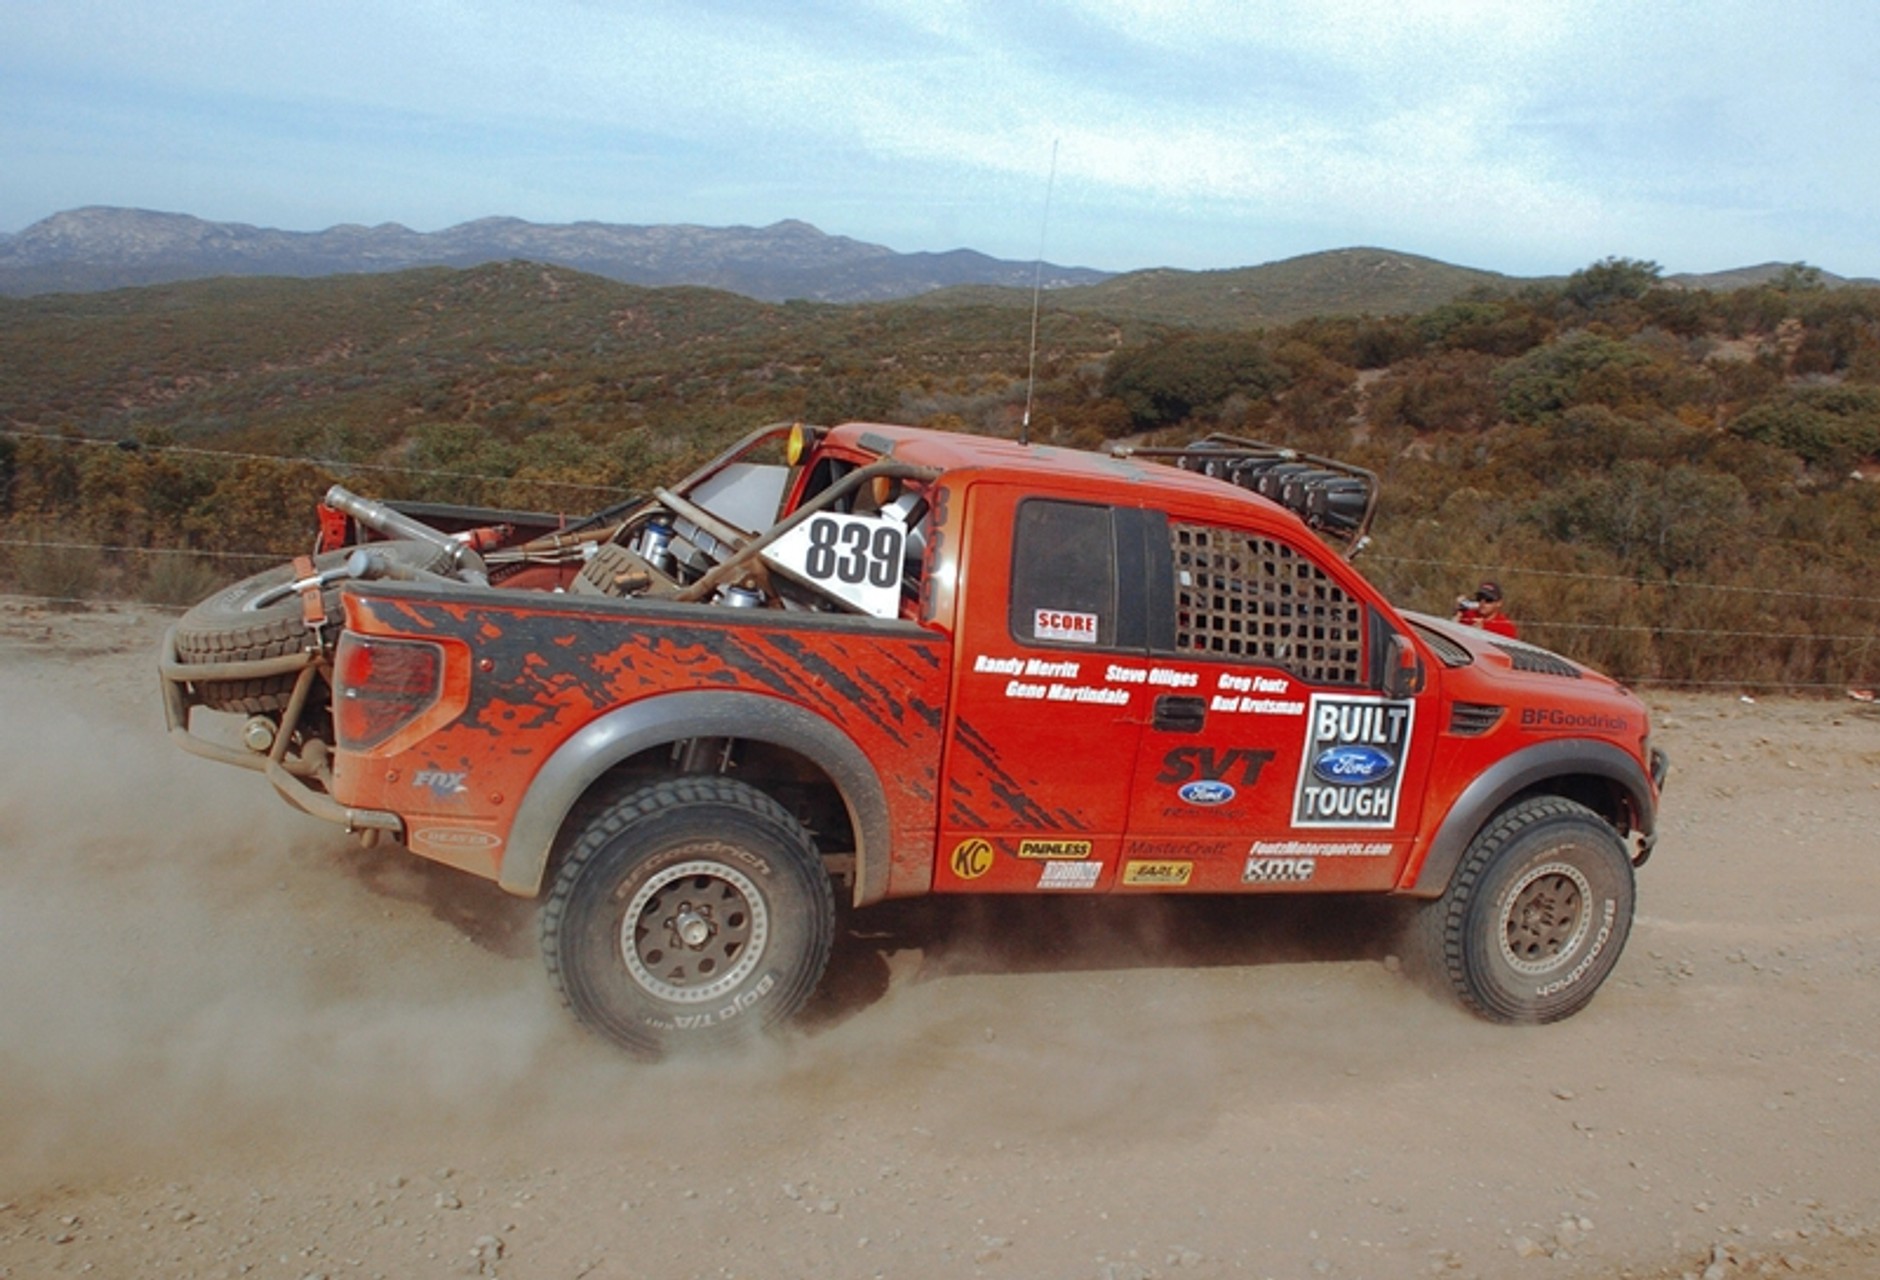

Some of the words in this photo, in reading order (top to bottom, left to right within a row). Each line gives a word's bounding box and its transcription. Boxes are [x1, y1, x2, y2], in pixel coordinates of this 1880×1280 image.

[805, 517, 902, 588] 839
[1038, 613, 1094, 632] SCORE
[974, 655, 1025, 676] Randy
[1025, 659, 1080, 678] Merritt
[1105, 664, 1147, 683] Steve
[1005, 680, 1047, 699] Gene
[1047, 684, 1130, 705] Martindale
[1218, 673, 1252, 692] Greg
[1317, 704, 1407, 743] BUILT
[1521, 708, 1628, 730] BFGoodrich
[1156, 746, 1277, 785] SVT
[1332, 753, 1377, 775] Ford
[1304, 787, 1390, 816] TOUGH
[955, 841, 990, 876] KC
[1022, 842, 1088, 855] PAINLESS
[1536, 899, 1616, 996] BFGoodrich
[718, 973, 775, 1021] Baja
[673, 1014, 717, 1030] T/A
